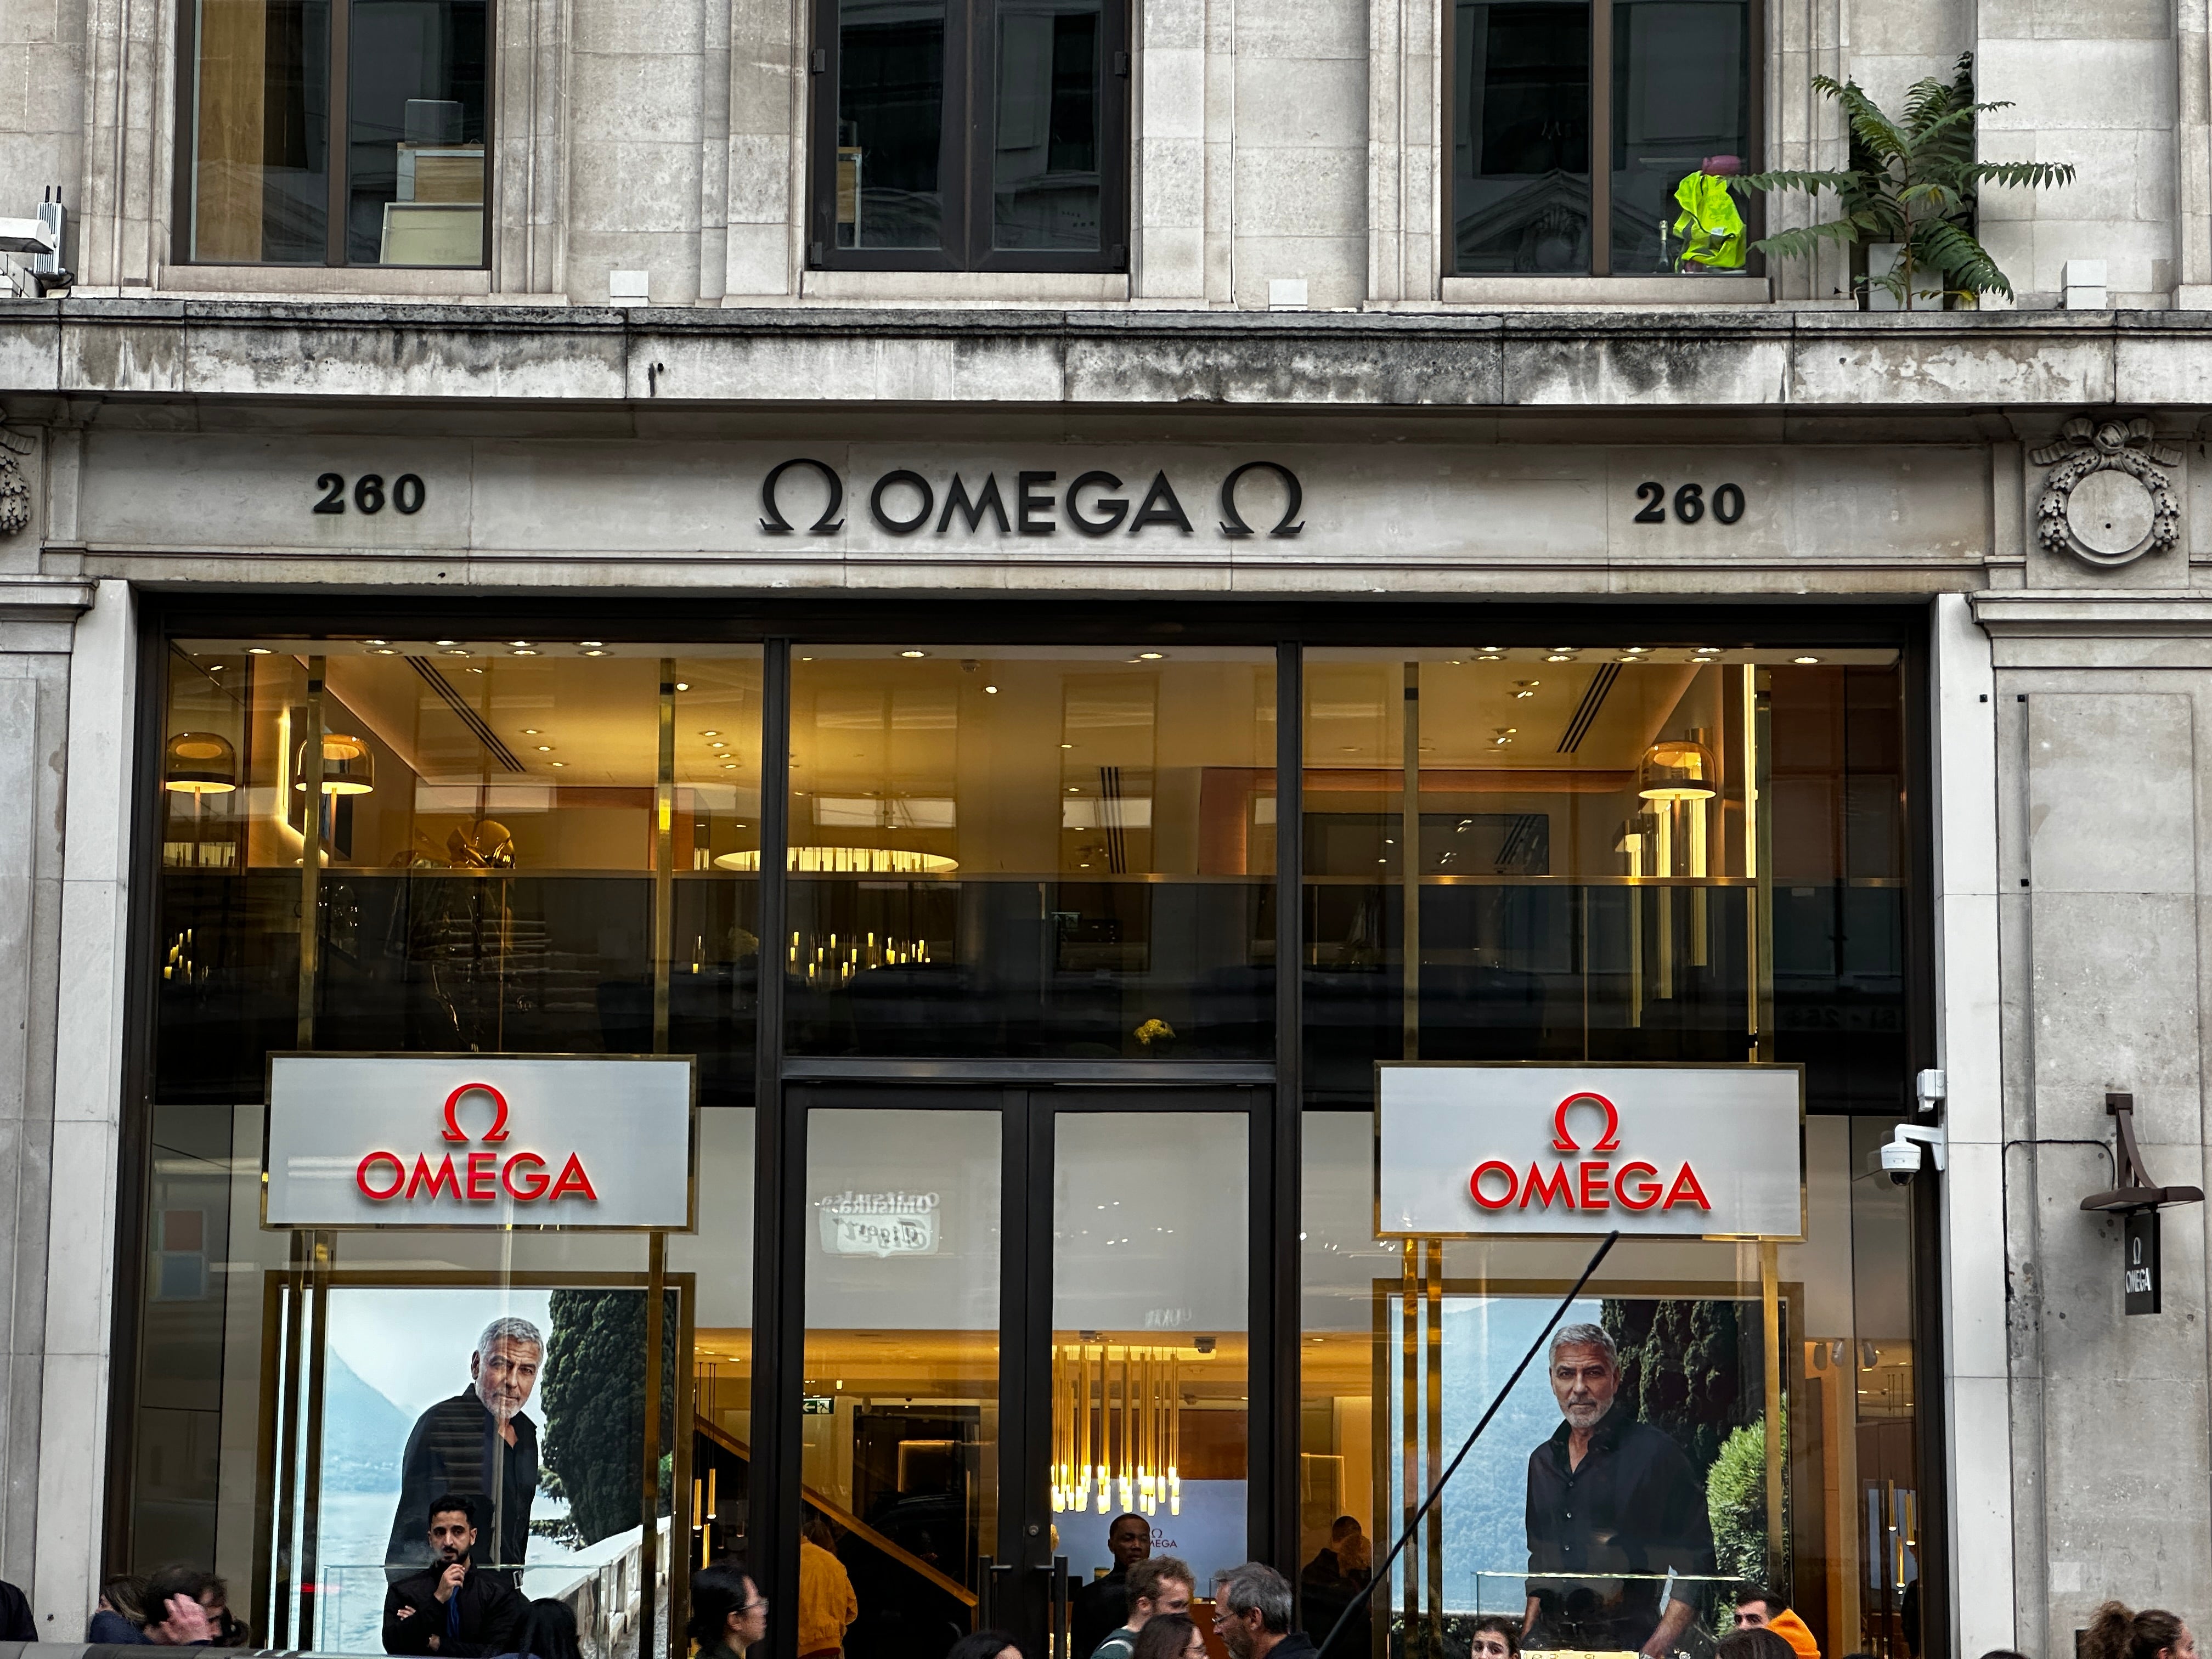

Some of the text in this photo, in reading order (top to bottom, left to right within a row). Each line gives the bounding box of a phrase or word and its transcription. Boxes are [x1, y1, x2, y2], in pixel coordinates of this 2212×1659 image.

[313, 473, 425, 515] 260
[871, 469, 1194, 534] OMEGA
[1634, 482, 1745, 524] 260
[356, 1151, 597, 1200] OMEGA
[1470, 1160, 1712, 1210] OMEGA
[2126, 1268, 2152, 1293] OMEGA
[1150, 1539, 1177, 1548] MEGA
